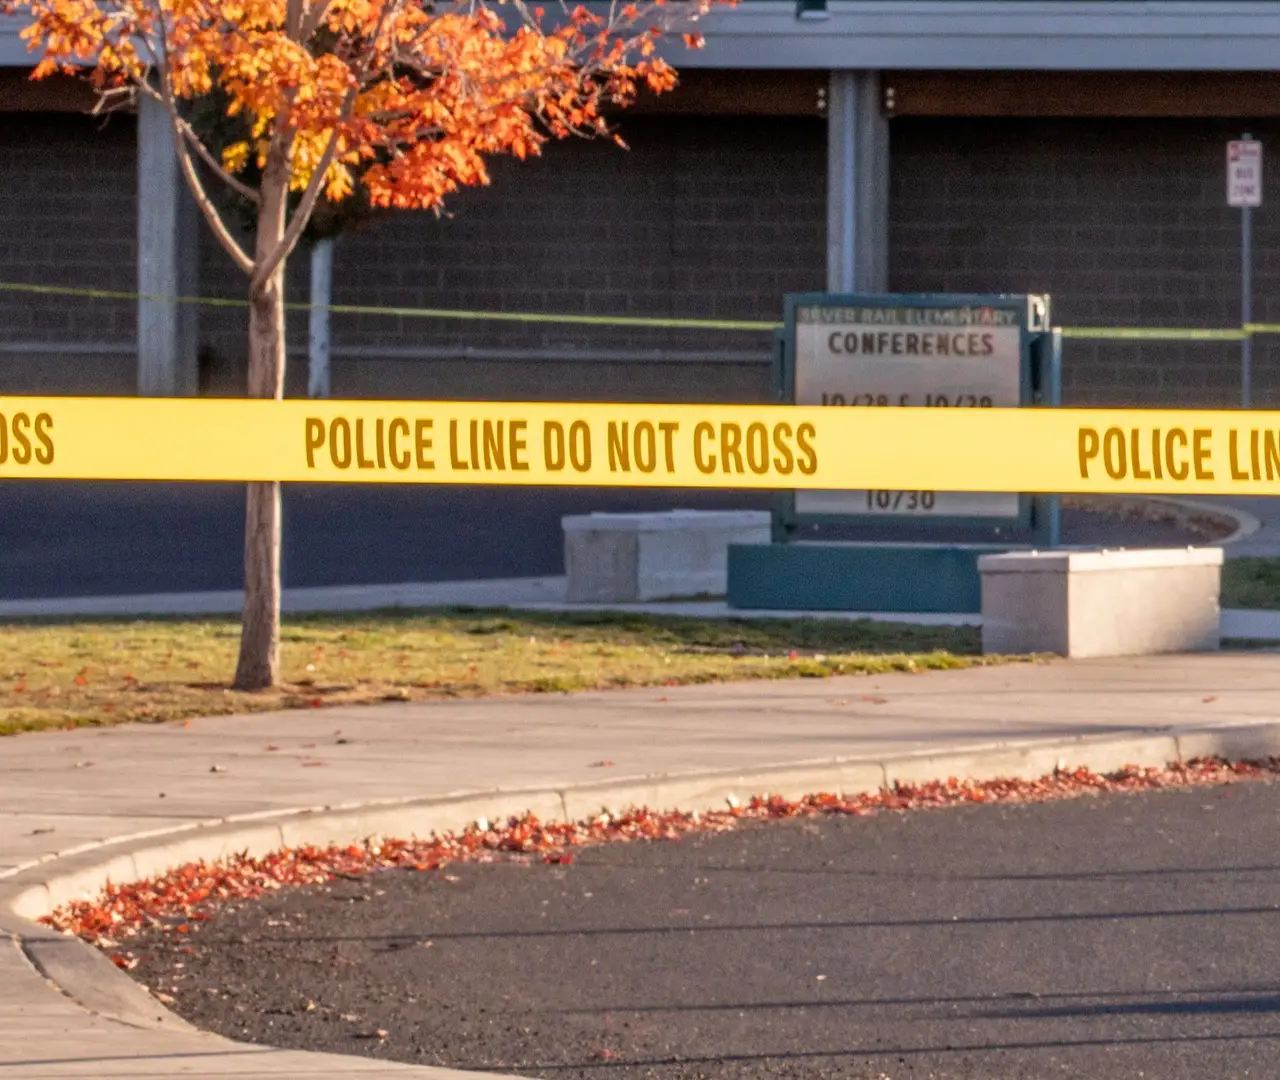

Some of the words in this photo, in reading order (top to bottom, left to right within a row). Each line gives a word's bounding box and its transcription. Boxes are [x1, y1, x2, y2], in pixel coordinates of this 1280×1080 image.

[827, 331, 994, 356] CONFERENCES
[305, 416, 436, 470] POLICE
[449, 419, 530, 471] LINE
[543, 419, 592, 473] DO
[607, 420, 680, 474] NOT
[693, 421, 818, 476] CROSS
[1078, 427, 1215, 481] POLICE
[866, 490, 935, 511] 10/30
